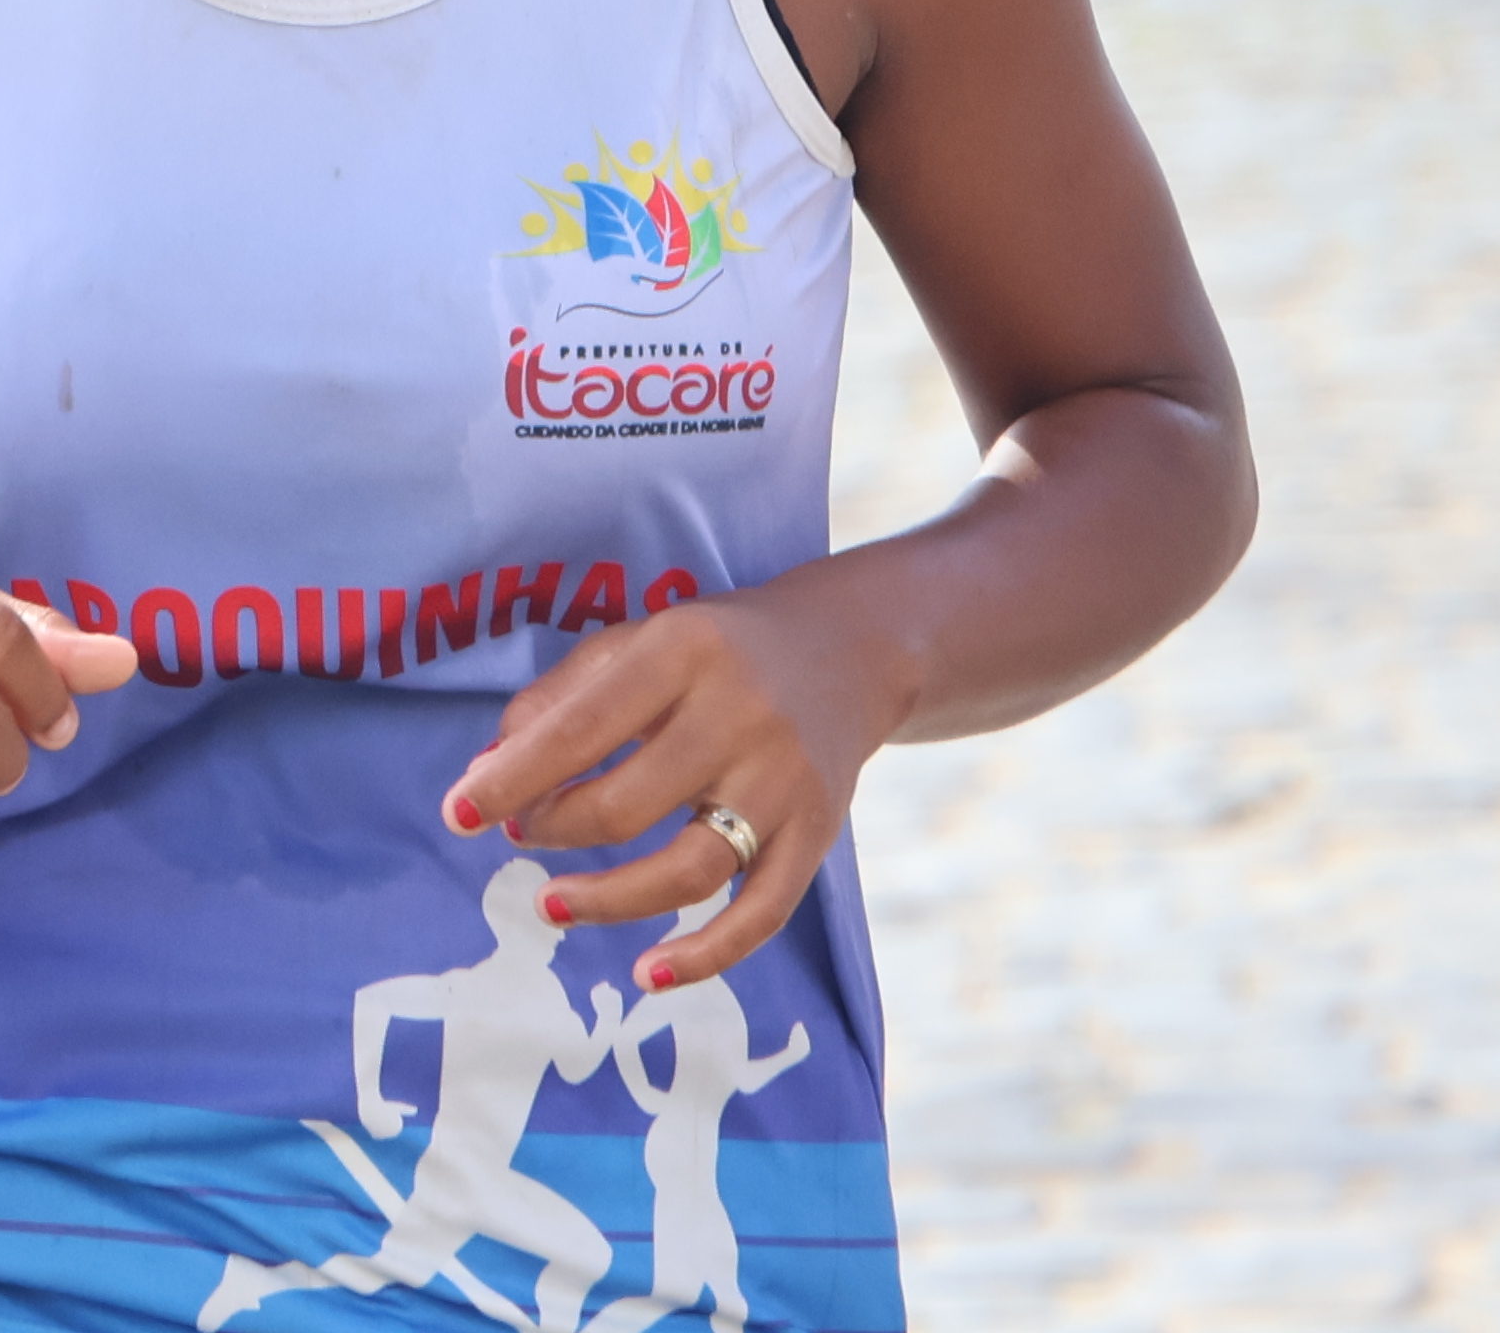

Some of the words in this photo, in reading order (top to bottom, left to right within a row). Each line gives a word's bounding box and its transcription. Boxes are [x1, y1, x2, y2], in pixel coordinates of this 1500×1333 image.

[560, 344, 705, 359] PREFEITURA
[720, 342, 742, 356] DE
[515, 424, 592, 438] CUIDANDO
[595, 424, 616, 438] DA
[618, 421, 668, 437] CIDADE
[681, 420, 699, 434] DA
